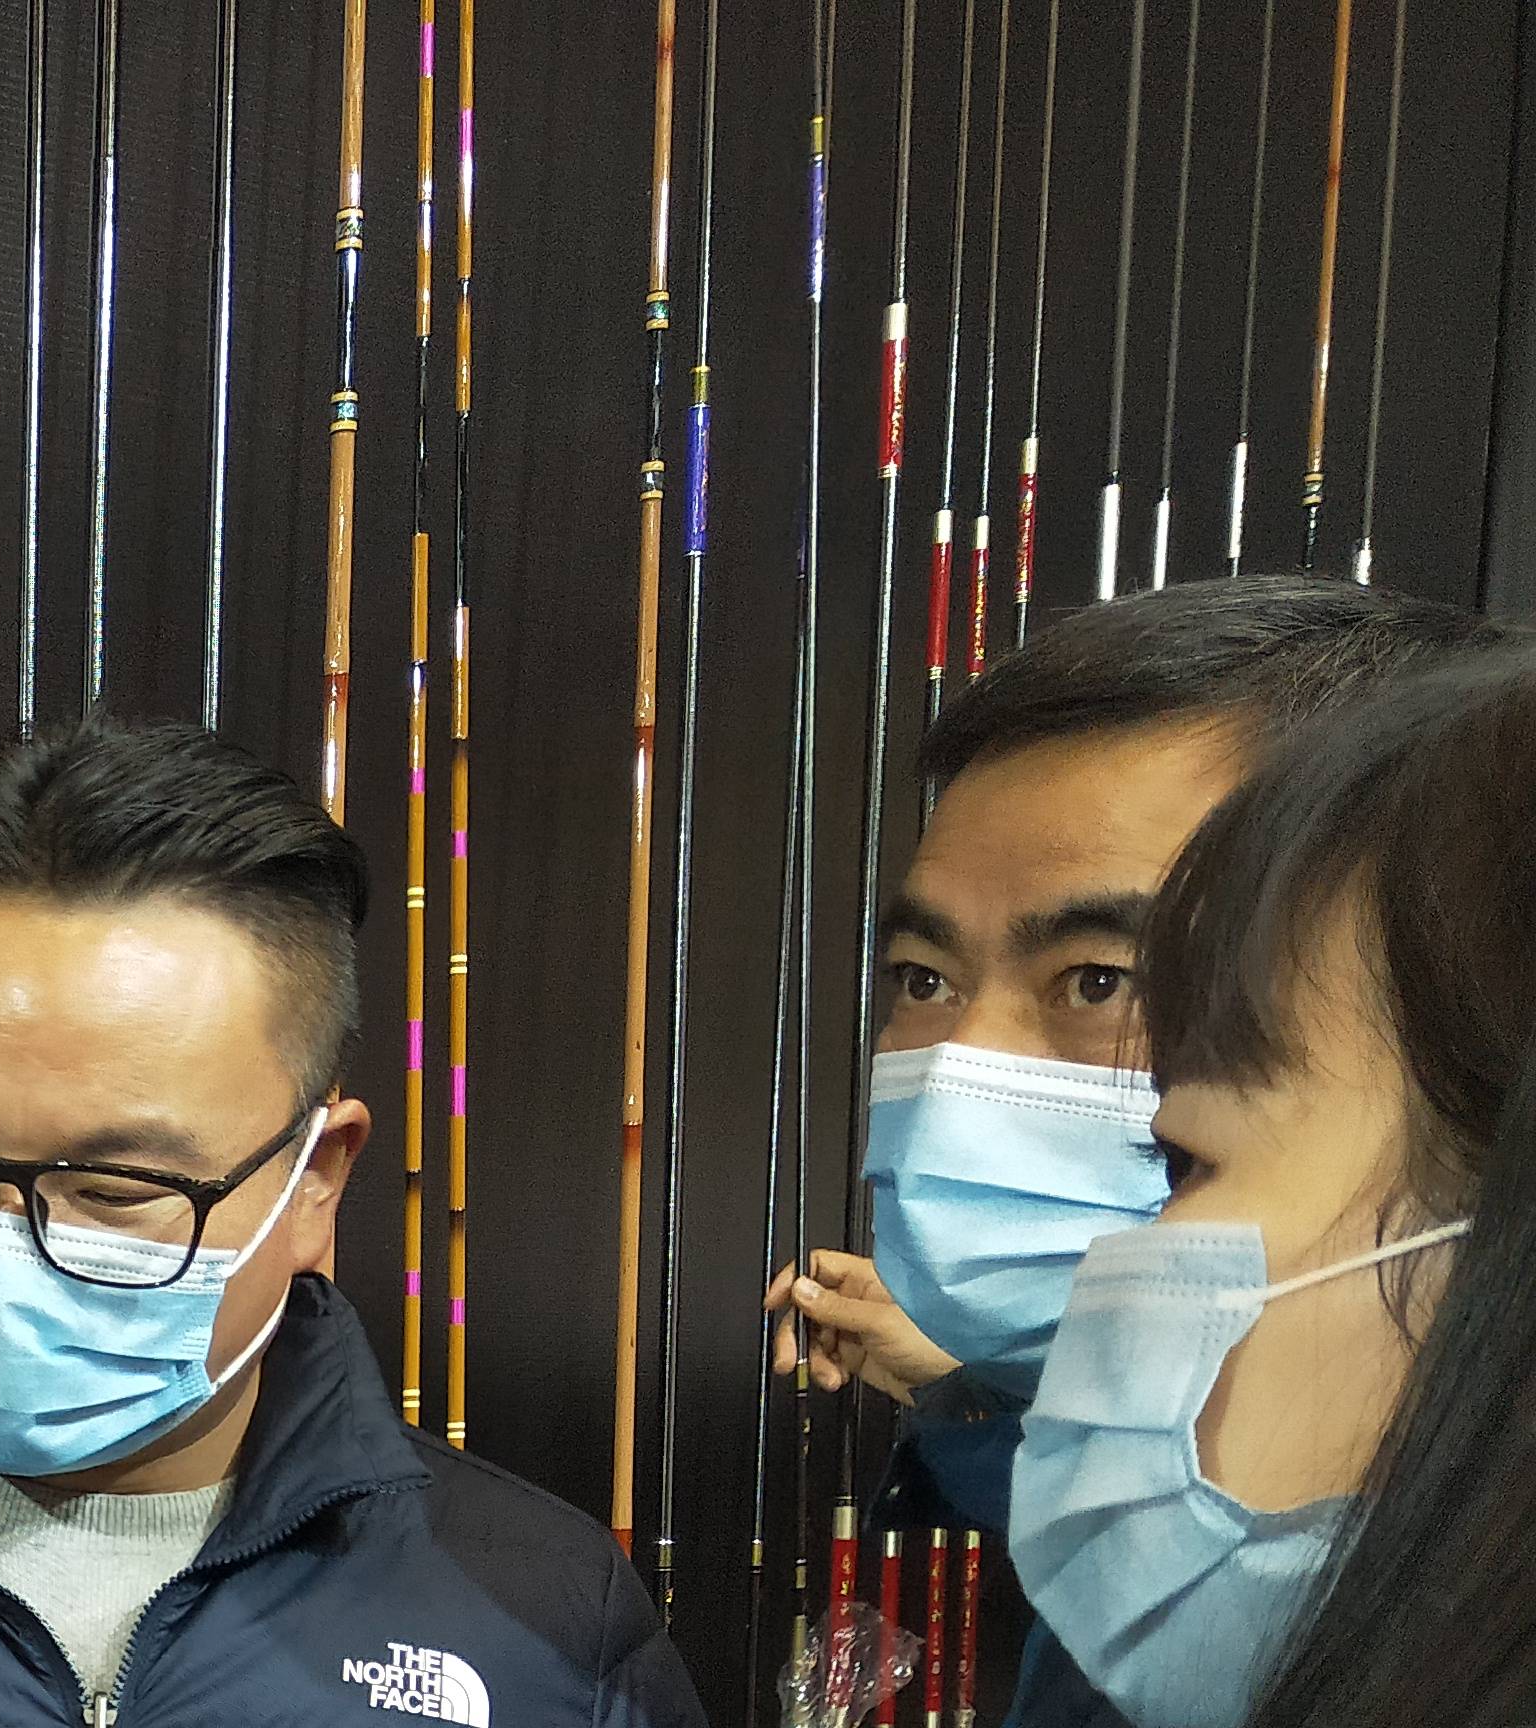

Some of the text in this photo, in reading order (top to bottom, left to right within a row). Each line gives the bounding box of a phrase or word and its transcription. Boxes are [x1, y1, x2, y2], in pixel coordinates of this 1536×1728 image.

[387, 1642, 442, 1672] THE
[341, 1658, 441, 1695] NORTH
[369, 1685, 441, 1718] FACE
